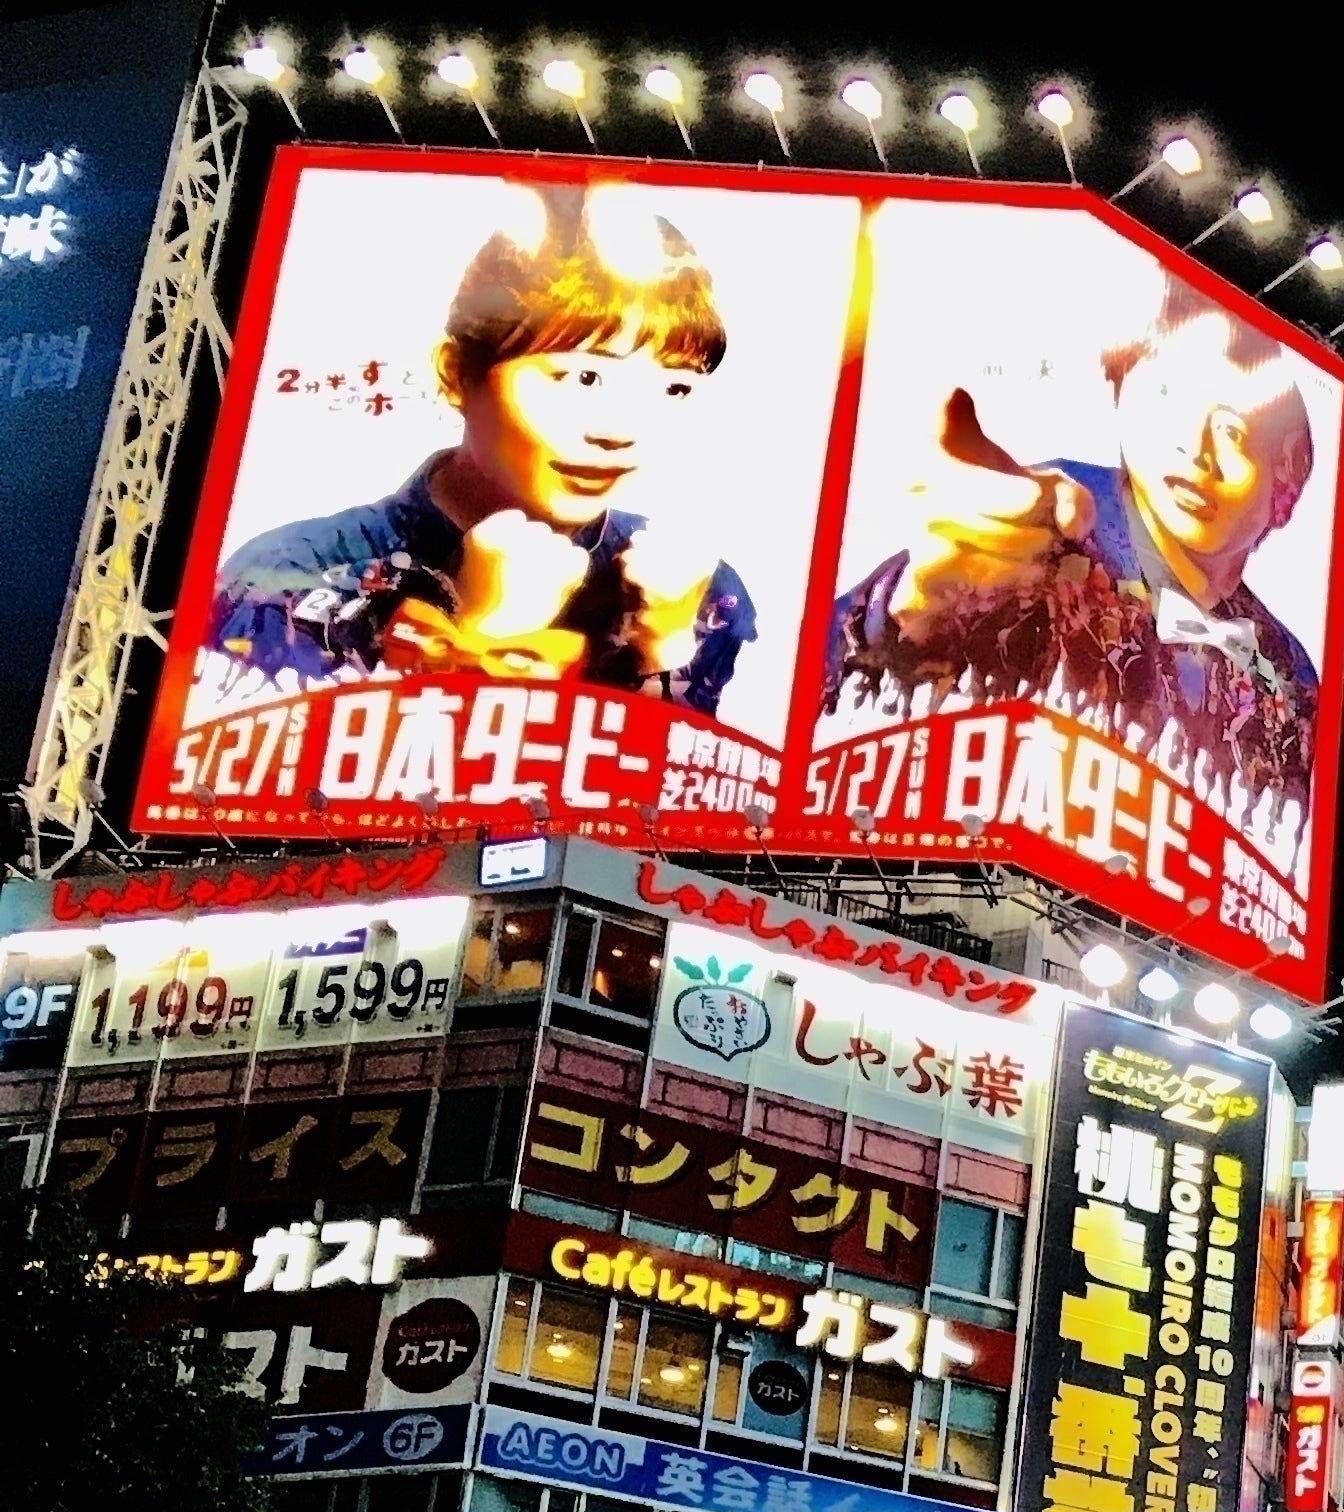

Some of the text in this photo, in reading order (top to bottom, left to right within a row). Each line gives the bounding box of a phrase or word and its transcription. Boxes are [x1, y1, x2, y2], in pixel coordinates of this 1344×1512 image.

[169, 708, 290, 798] 5/27
[319, 684, 650, 808] 日本ダービー
[803, 731, 911, 819] 5/27
[943, 714, 1212, 903] 日本ダービー
[3, 984, 72, 1030] 9F
[276, 957, 450, 1039] 1,599円
[794, 999, 1026, 1118] しゃぶ葉
[530, 1102, 922, 1254] コンタクト
[243, 1217, 434, 1292] ガスト
[1157, 1142, 1205, 1355] MOMOIRO
[796, 1288, 975, 1380] ガスト
[504, 1426, 626, 1477] AEON
